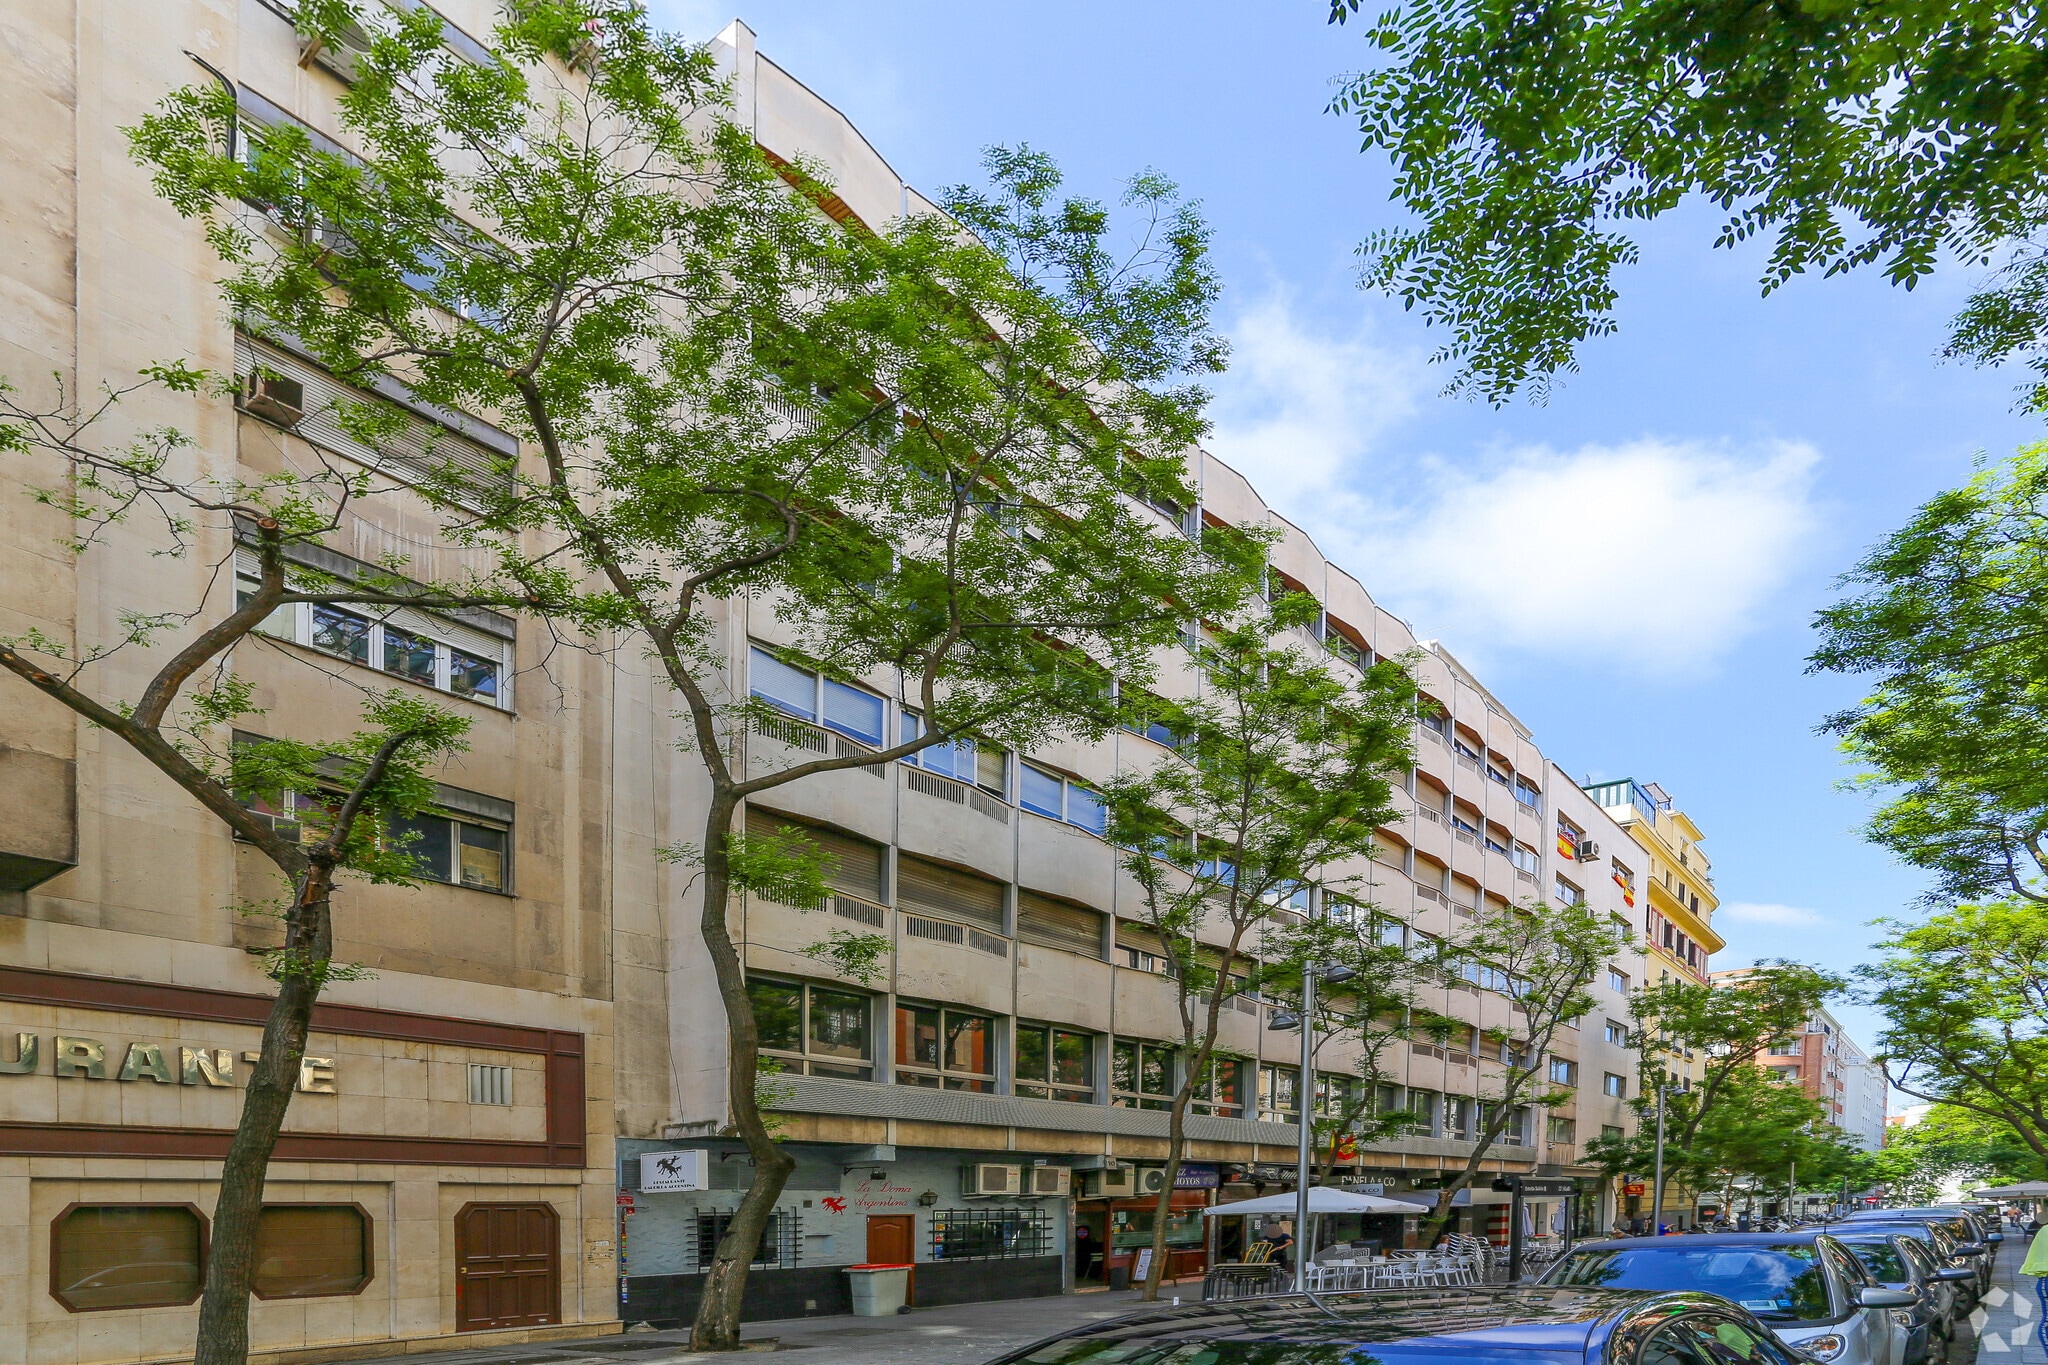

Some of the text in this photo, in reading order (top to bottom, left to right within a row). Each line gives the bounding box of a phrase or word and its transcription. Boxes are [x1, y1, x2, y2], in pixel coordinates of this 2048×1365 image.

[0, 1032, 337, 1094] URANE
[877, 1180, 913, 1193] Doma
[1383, 1177, 1396, 1187] CO
